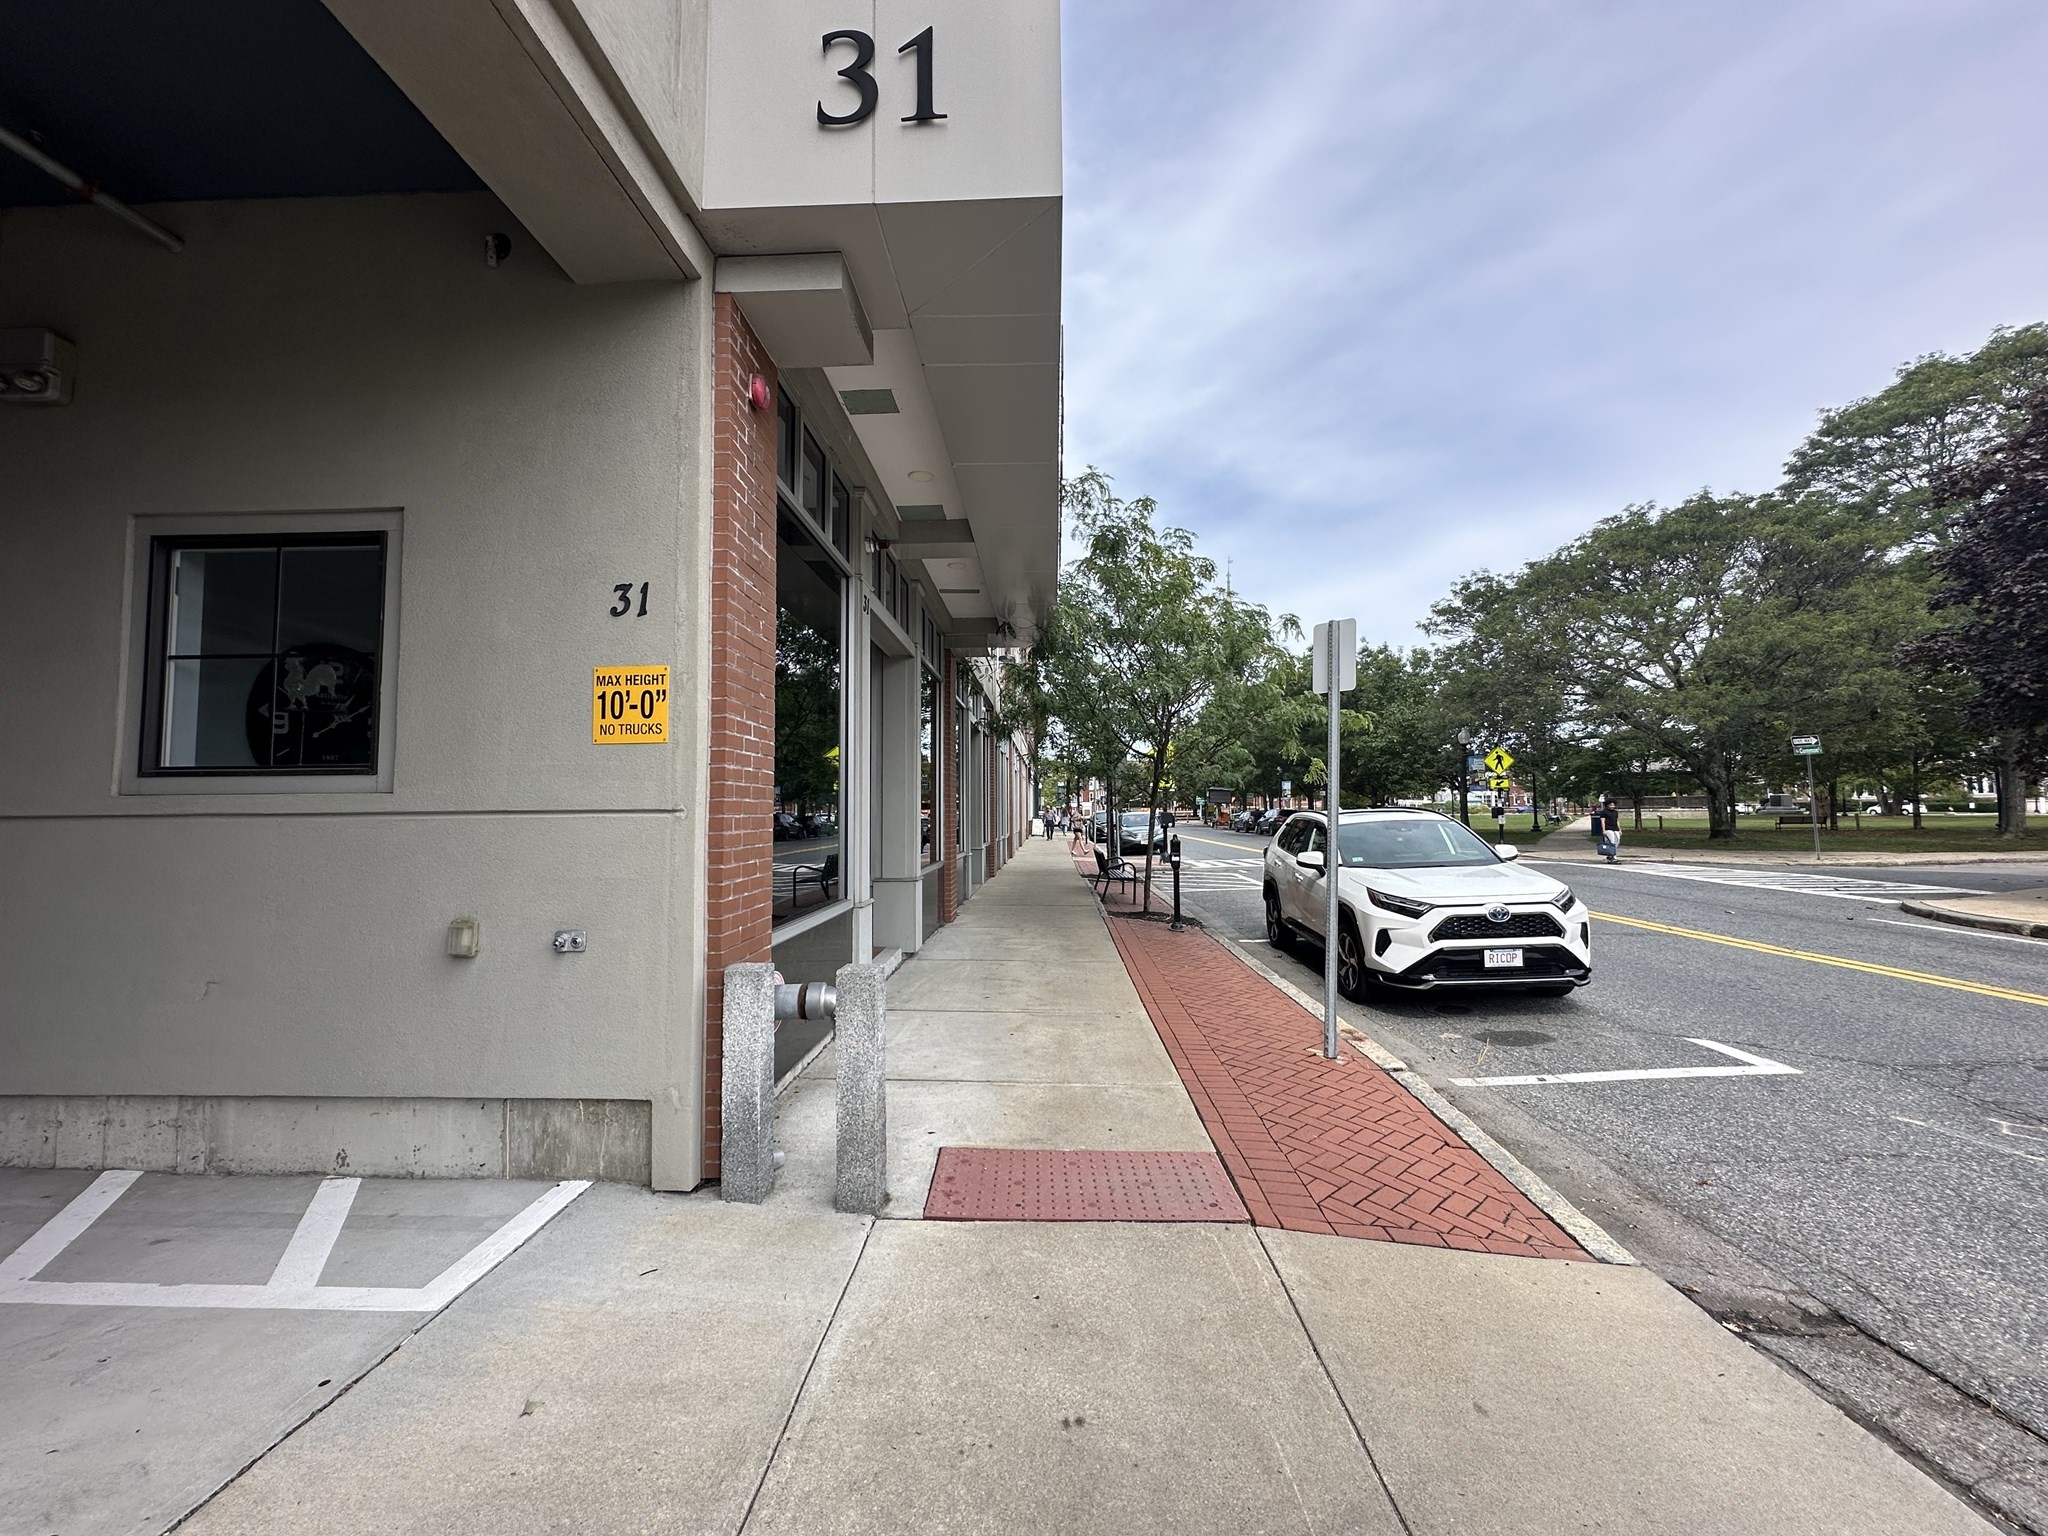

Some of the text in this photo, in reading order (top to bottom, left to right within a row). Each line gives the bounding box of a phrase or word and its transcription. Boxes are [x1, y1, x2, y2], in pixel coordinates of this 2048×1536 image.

[817, 25, 948, 125] 31
[610, 582, 649, 617] 31
[596, 674, 667, 686] MAX HEIGHT
[599, 723, 663, 736] NO TRUCKS
